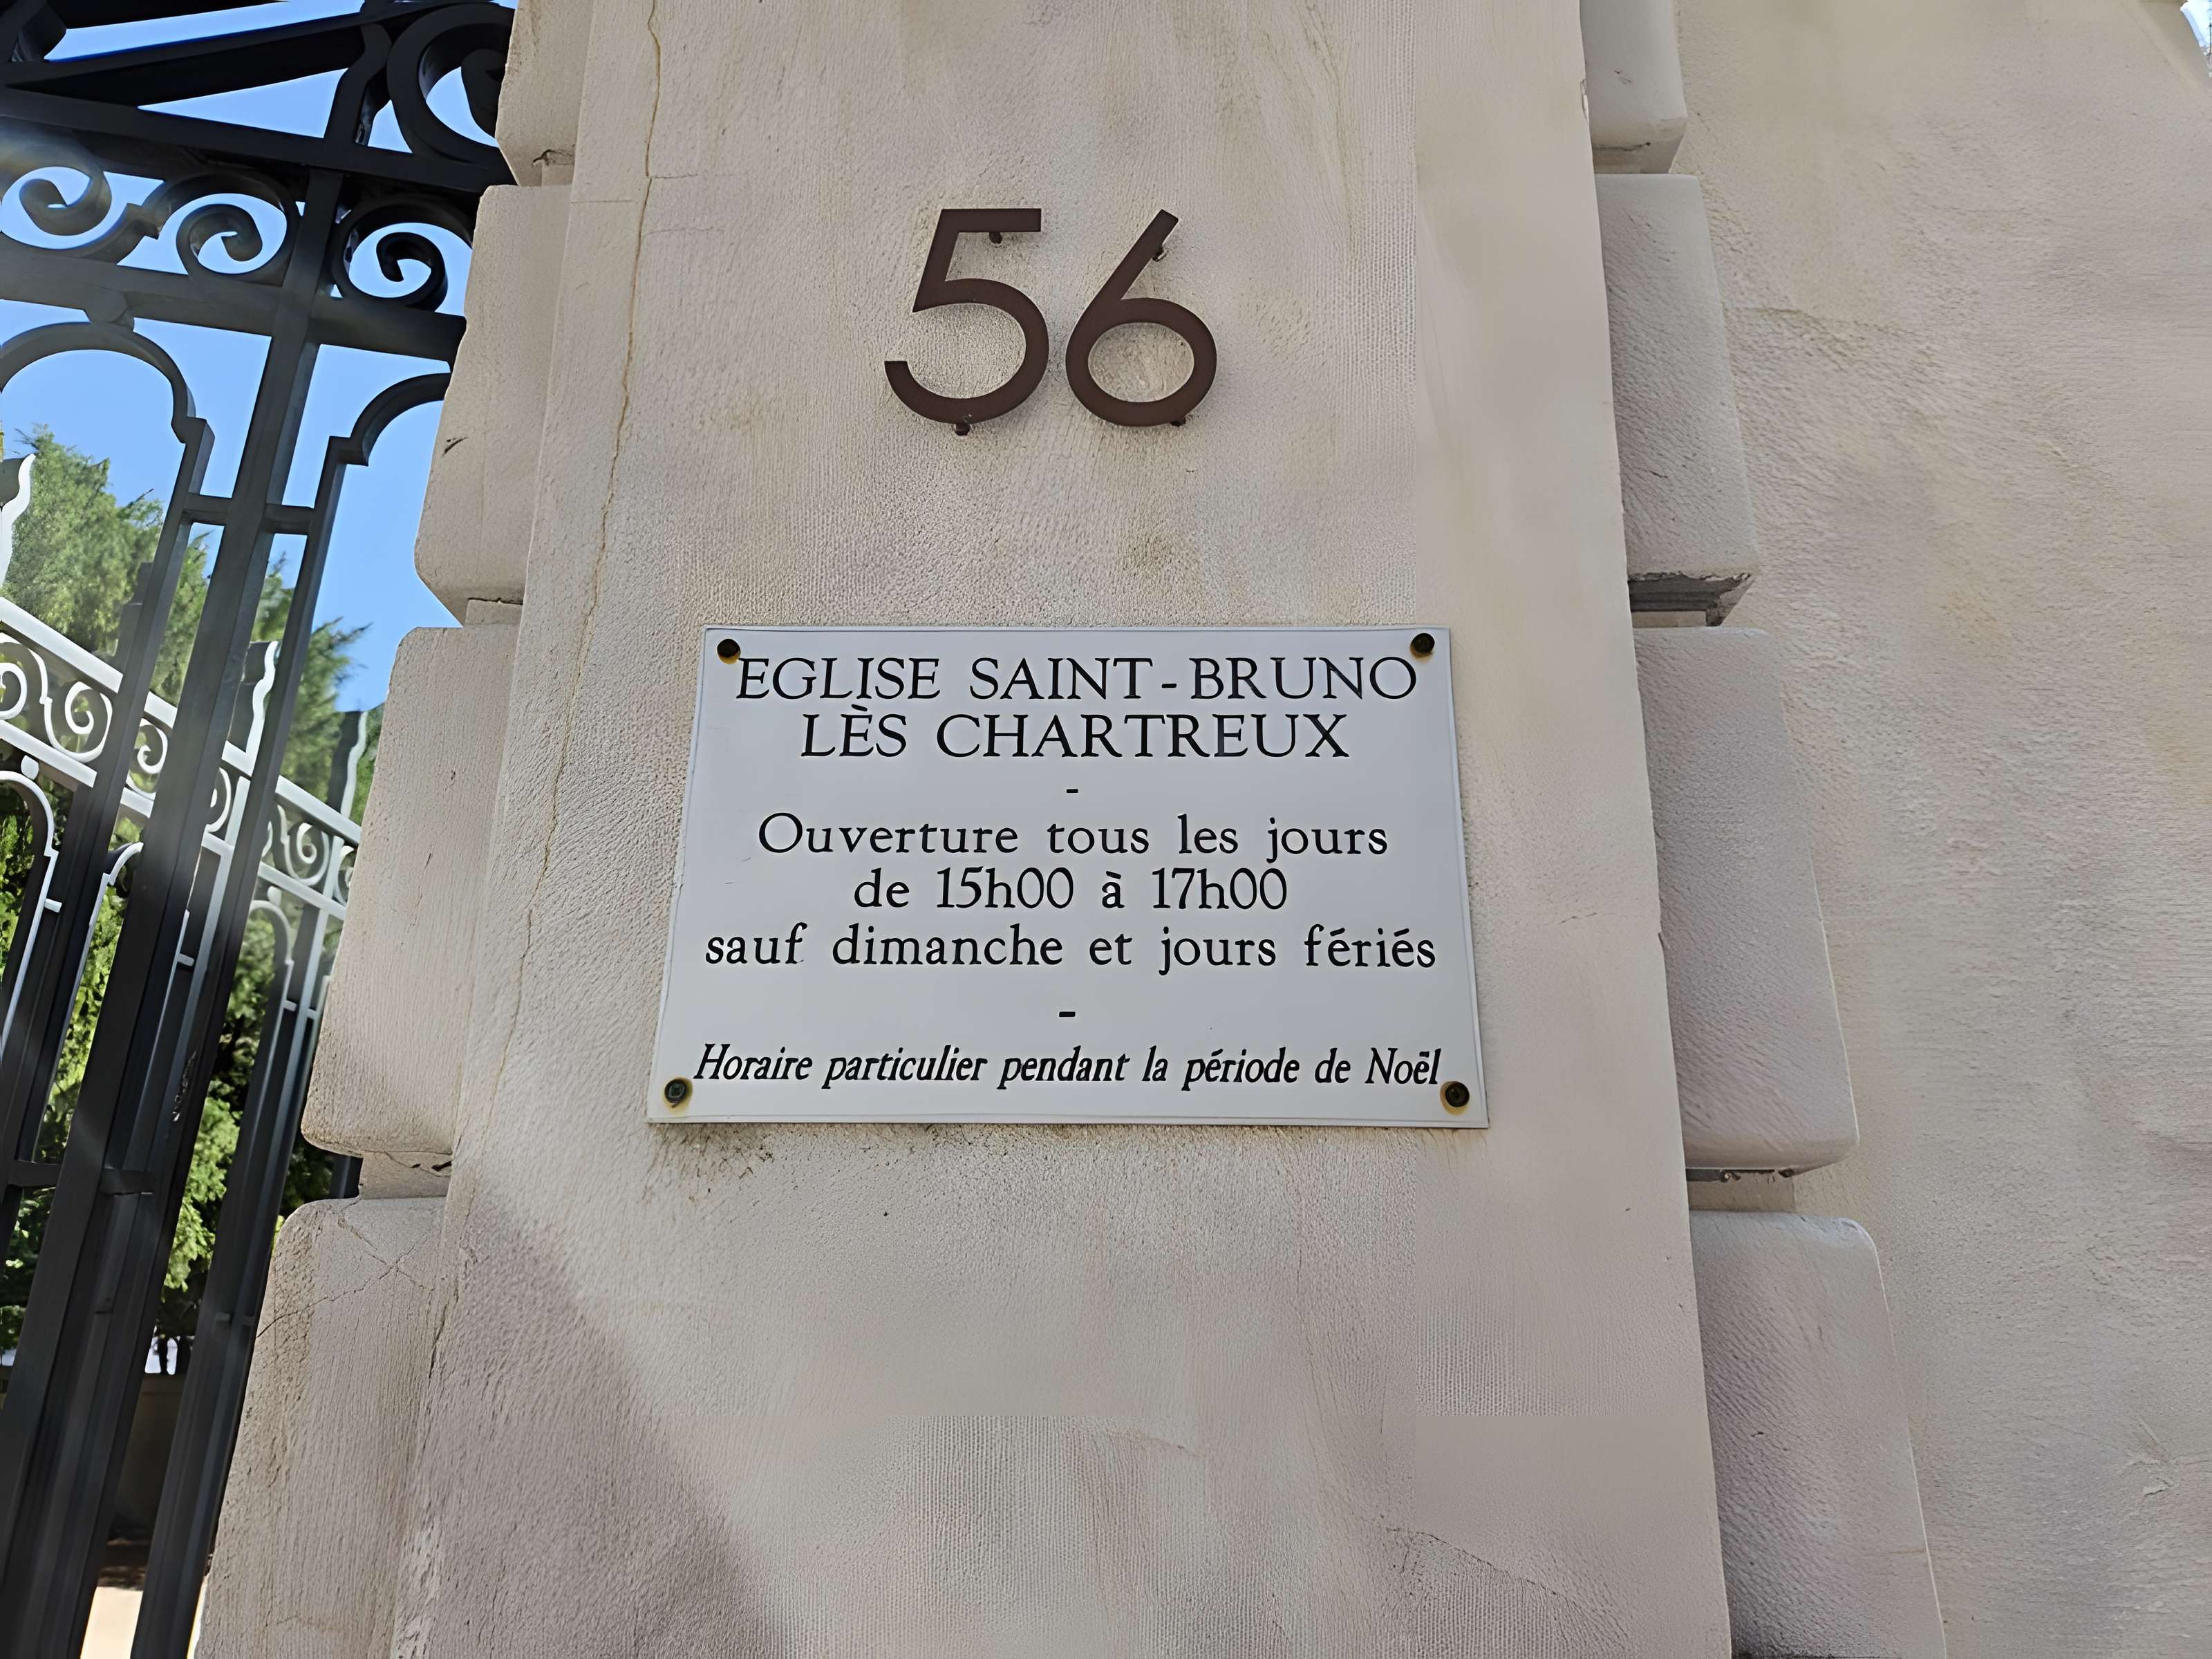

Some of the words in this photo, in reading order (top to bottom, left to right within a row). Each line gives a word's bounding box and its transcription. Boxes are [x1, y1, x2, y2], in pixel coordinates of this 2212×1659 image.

[884, 208, 1217, 427] 56
[735, 657, 941, 700] EGLISE
[800, 704, 908, 758] LÈS
[936, 713, 1351, 758] CHARTREUX
[758, 812, 1019, 854] Ouverture
[1046, 823, 1150, 855] tous
[1177, 813, 1239, 855] les
[1265, 816, 1388, 864] jours
[853, 867, 910, 908] de
[936, 865, 1074, 910] 15h00
[1100, 870, 1125, 910] à
[1151, 867, 1288, 911] 17h00
[704, 921, 809, 966] sauf
[832, 922, 1063, 966] dimanche
[1088, 932, 1134, 966] et
[1157, 925, 1277, 976] jours
[1303, 923, 1436, 969] fériés
[693, 1042, 813, 1081] Horaire
[820, 1044, 988, 1090] particulier
[995, 1044, 1132, 1091] pendant
[1141, 1044, 1168, 1082] la
[1181, 1046, 1301, 1092] période
[1313, 1047, 1352, 1085] de
[1364, 1047, 1443, 1085] Noël
